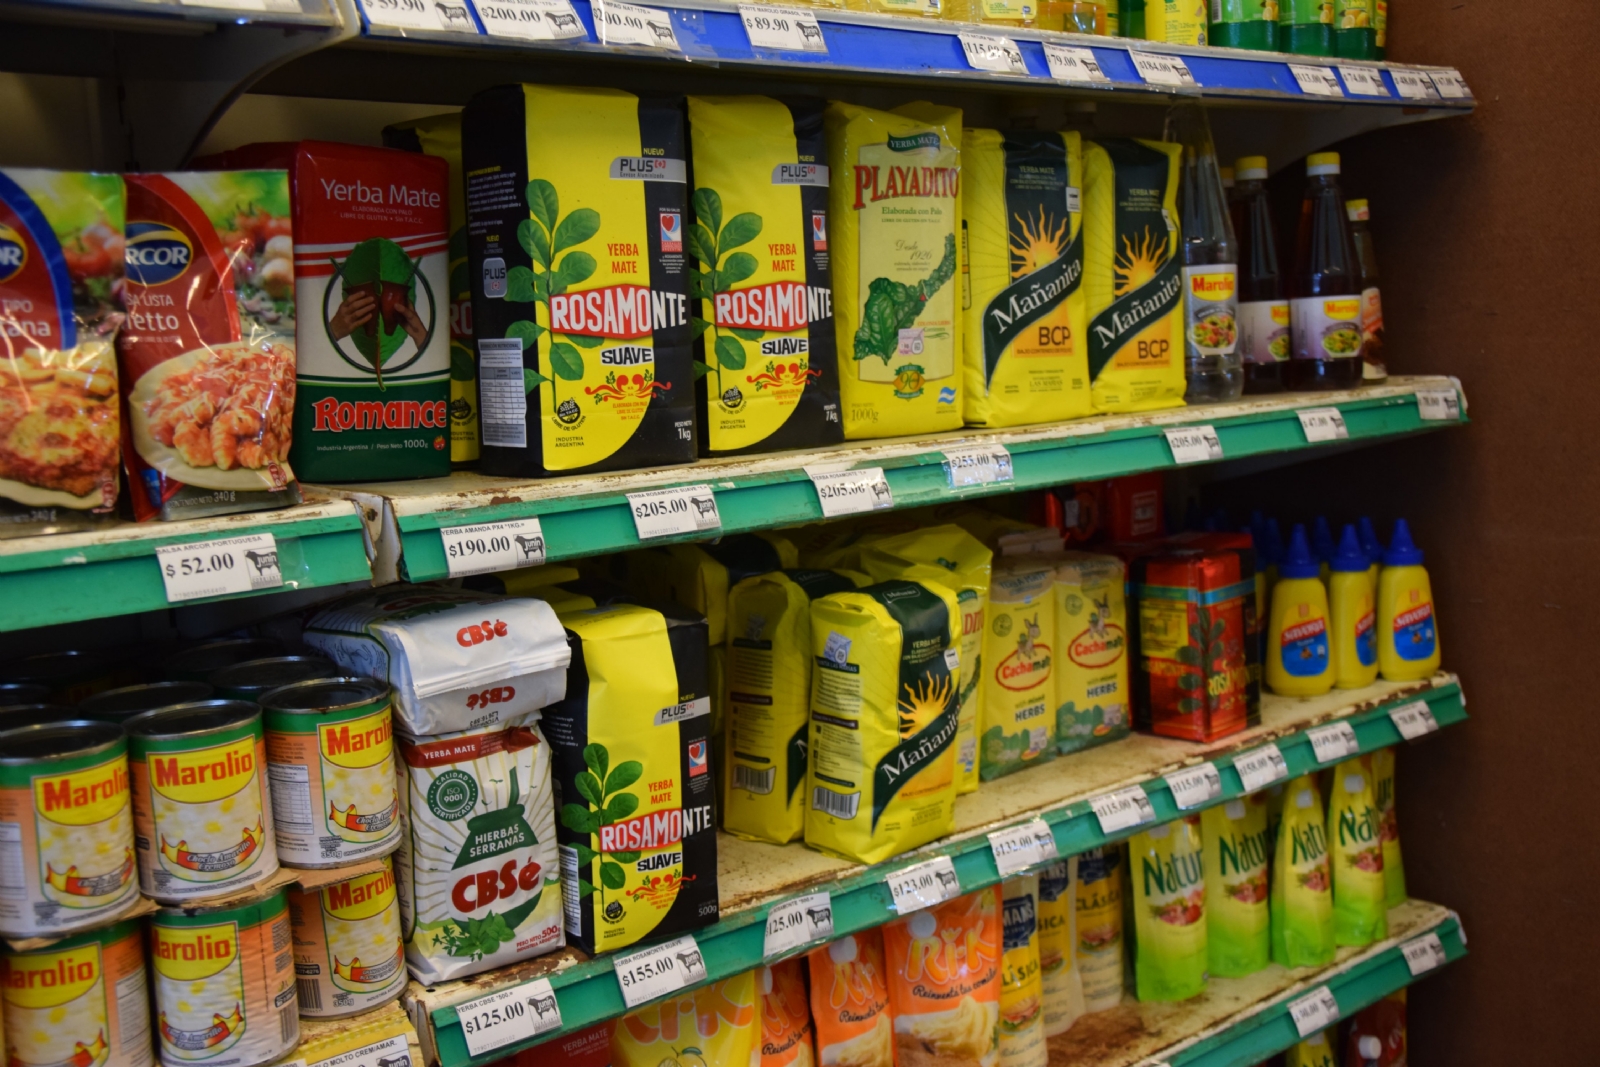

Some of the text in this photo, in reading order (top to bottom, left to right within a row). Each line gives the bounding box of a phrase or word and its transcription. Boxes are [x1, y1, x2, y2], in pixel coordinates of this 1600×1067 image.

[482, 6, 543, 23] $200.00
[755, 17, 790, 32] 89.90
[643, 148, 665, 156] NUEVO
[890, 136, 940, 149] YERBA MATE
[619, 158, 654, 172] PLUS
[781, 165, 808, 177] PLUS
[1019, 165, 1040, 174] YERBA
[320, 178, 441, 208] Yerba Mate
[852, 165, 960, 211] PLAYADITO
[352, 206, 385, 214] ELABORADA
[366, 214, 388, 222] GLUTEN
[881, 206, 917, 215] Elaborada
[125, 247, 189, 265] RCOR
[607, 243, 639, 257] YERBA
[768, 243, 797, 256] YERBA
[484, 267, 506, 280] PLUS
[611, 261, 638, 274] MATE
[772, 259, 795, 272] MATE
[716, 284, 833, 328] ROSAMONTE
[990, 258, 1082, 335] Mañanita
[551, 286, 687, 335] ROSAMONTE
[1093, 274, 1181, 350] Mañanita
[1038, 325, 1071, 347] BCP
[601, 346, 653, 365] SUAVE
[761, 338, 808, 356] SUAVE
[1137, 340, 1170, 360] BCP
[312, 397, 447, 432] Romance
[213, 491, 229, 501] 340
[627, 492, 646, 500] YERBA
[646, 490, 679, 499] ROSAMONTE
[635, 497, 688, 519] $205.00
[441, 528, 464, 536] YERBA
[464, 525, 492, 535] AMANDA
[157, 535, 263, 555] SALSA ARCOR PORTUGUESA
[449, 534, 511, 558] $190.00
[165, 551, 235, 579] $ 52.00
[456, 618, 508, 647] CBSé
[465, 685, 516, 711] CBSé
[1086, 682, 1118, 699] HERBS
[661, 703, 687, 719] PLUS
[1014, 703, 1046, 722] HERBS
[424, 749, 451, 761] YERBA
[453, 744, 476, 755] MATE
[155, 750, 253, 788] Marolio
[435, 771, 469, 786] CALIDAD
[446, 786, 460, 795] ISO
[648, 778, 674, 792] YERBA
[443, 793, 464, 803] 9001
[651, 791, 672, 805] MATE
[433, 800, 475, 820] CERTIFICADA
[475, 823, 520, 845] HIERBAS
[601, 804, 712, 850] ROSAMONTE
[469, 832, 525, 858] SERRANAS
[995, 835, 1033, 857] $132.00
[637, 852, 682, 872] SUAVE
[451, 856, 542, 914] CBSé
[894, 873, 934, 898] $123.00
[698, 903, 717, 918] 500g
[516, 937, 529, 947] PESO
[632, 946, 665, 962] ROSAMONTE
[664, 939, 683, 951] SUAVE
[3, 957, 94, 989] arolio
[622, 955, 675, 988] $155.00
[1001, 958, 1039, 986] LÁSICA
[457, 996, 495, 1015] YERBA CBSE
[465, 1000, 525, 1035] $125.00
[562, 1028, 609, 1052] YERBA MATE
[330, 1052, 354, 1067] MOLTO
